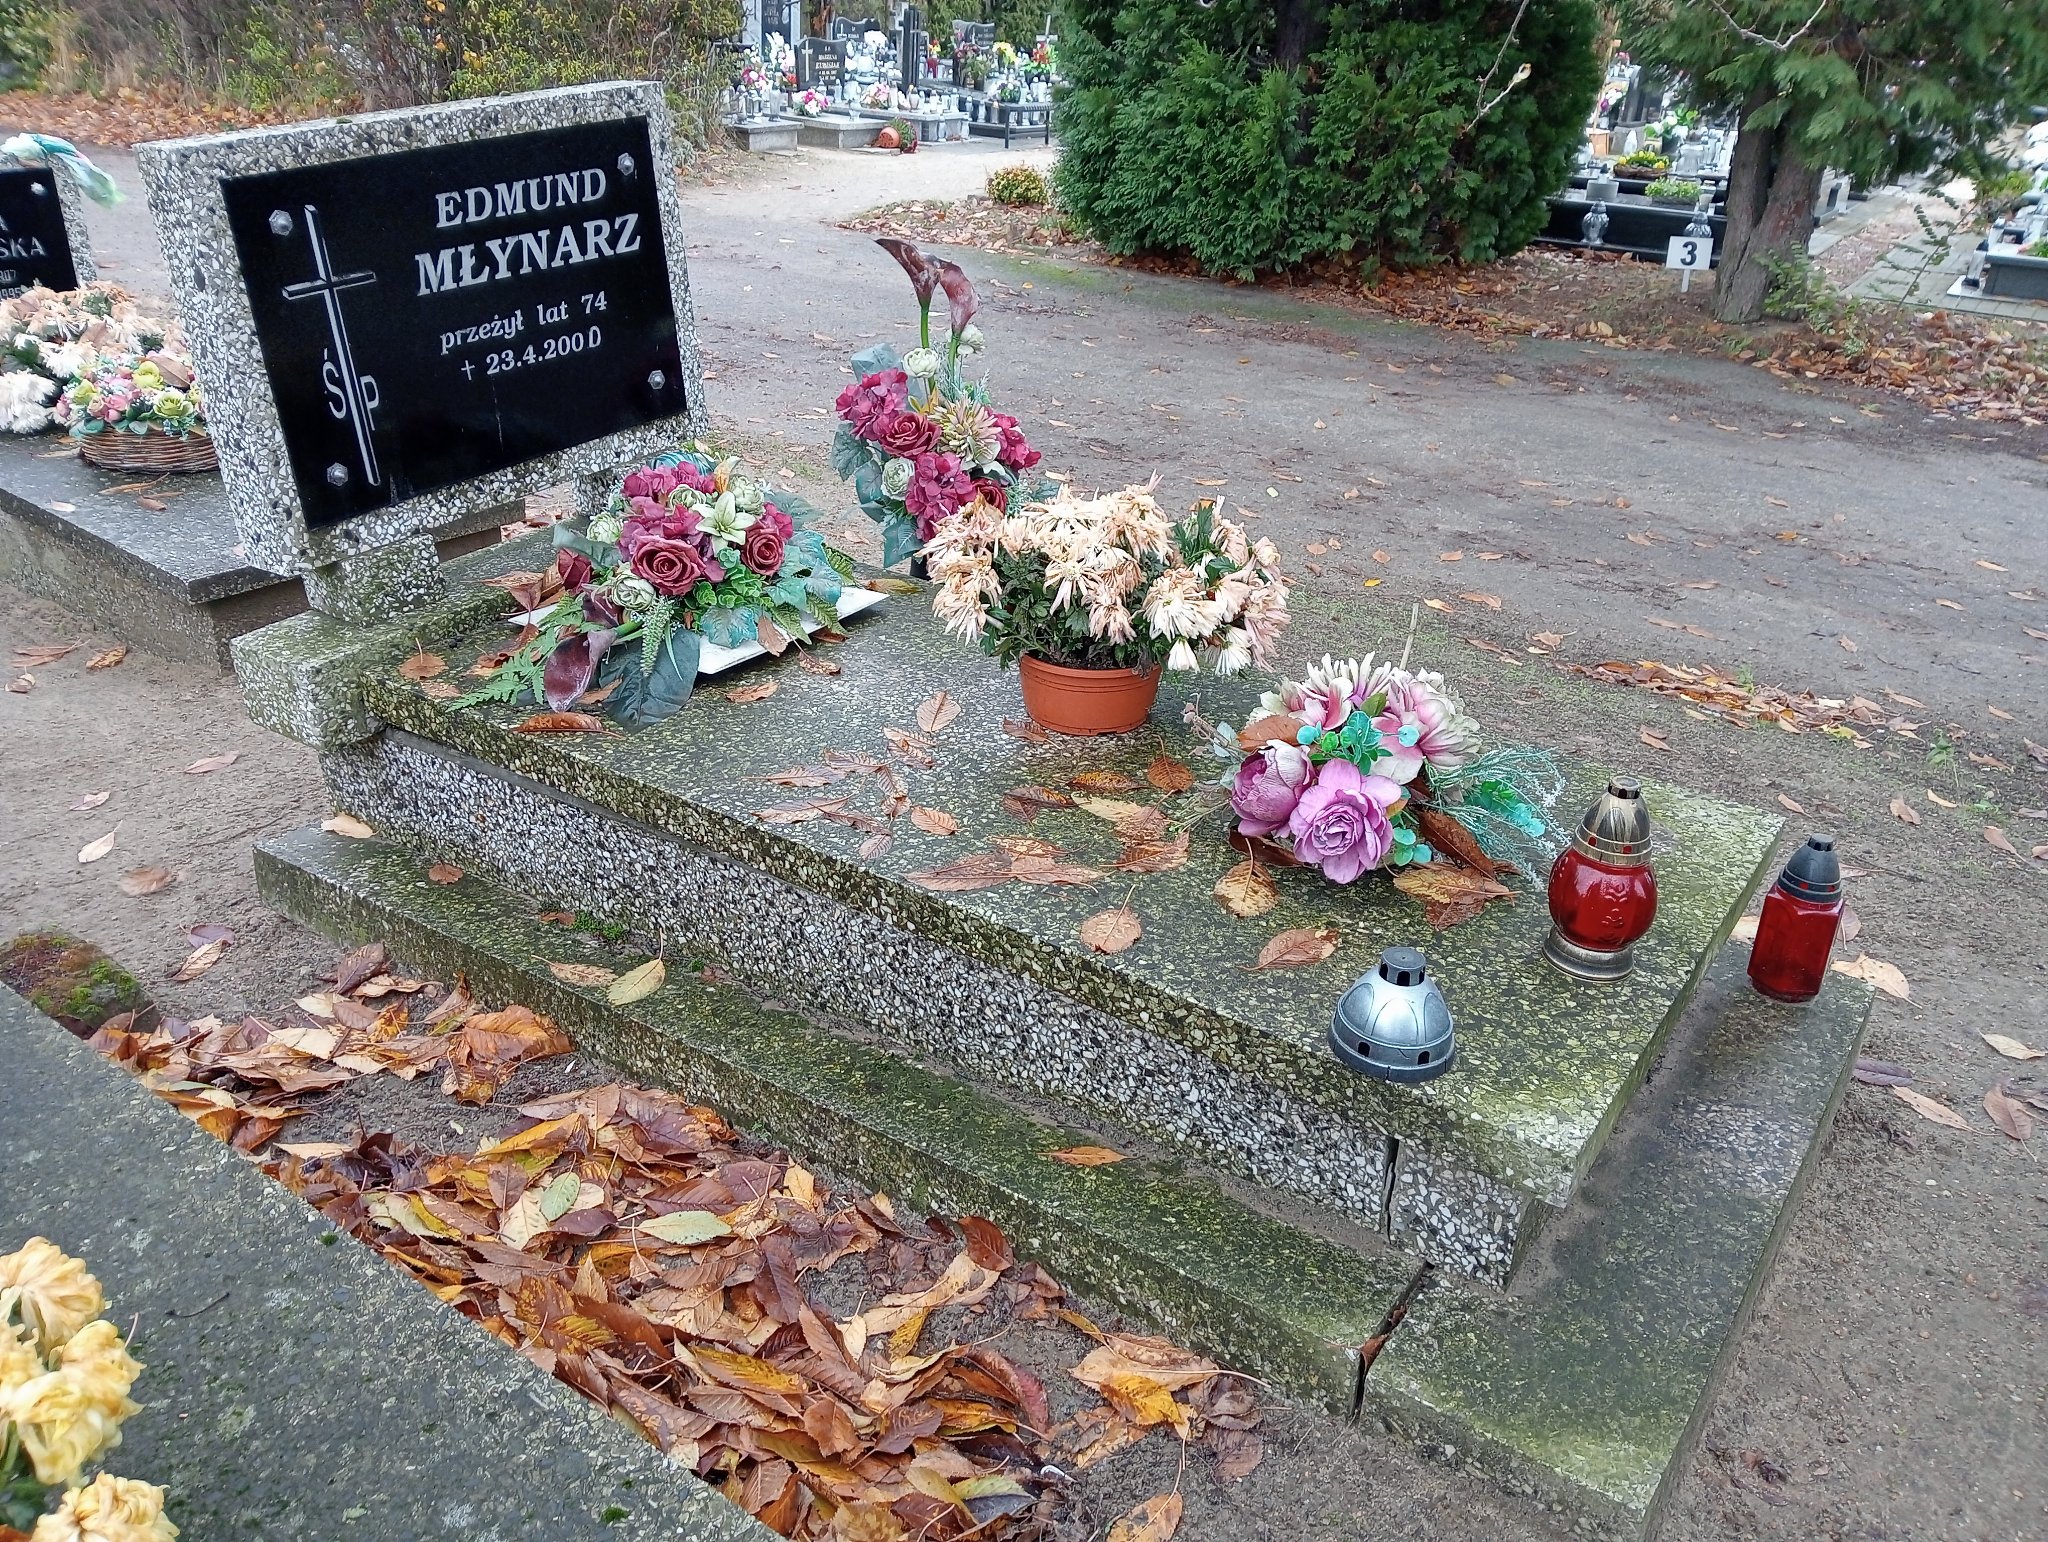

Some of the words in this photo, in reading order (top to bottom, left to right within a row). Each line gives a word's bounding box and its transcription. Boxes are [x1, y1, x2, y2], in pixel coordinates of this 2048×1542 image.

[435, 168, 607, 228] EDMUND
[414, 213, 640, 297] MŁYNARZ
[1680, 241, 1698, 266] 3
[439, 309, 525, 356] przeżył
[536, 300, 569, 326] lat
[580, 290, 608, 315] 74
